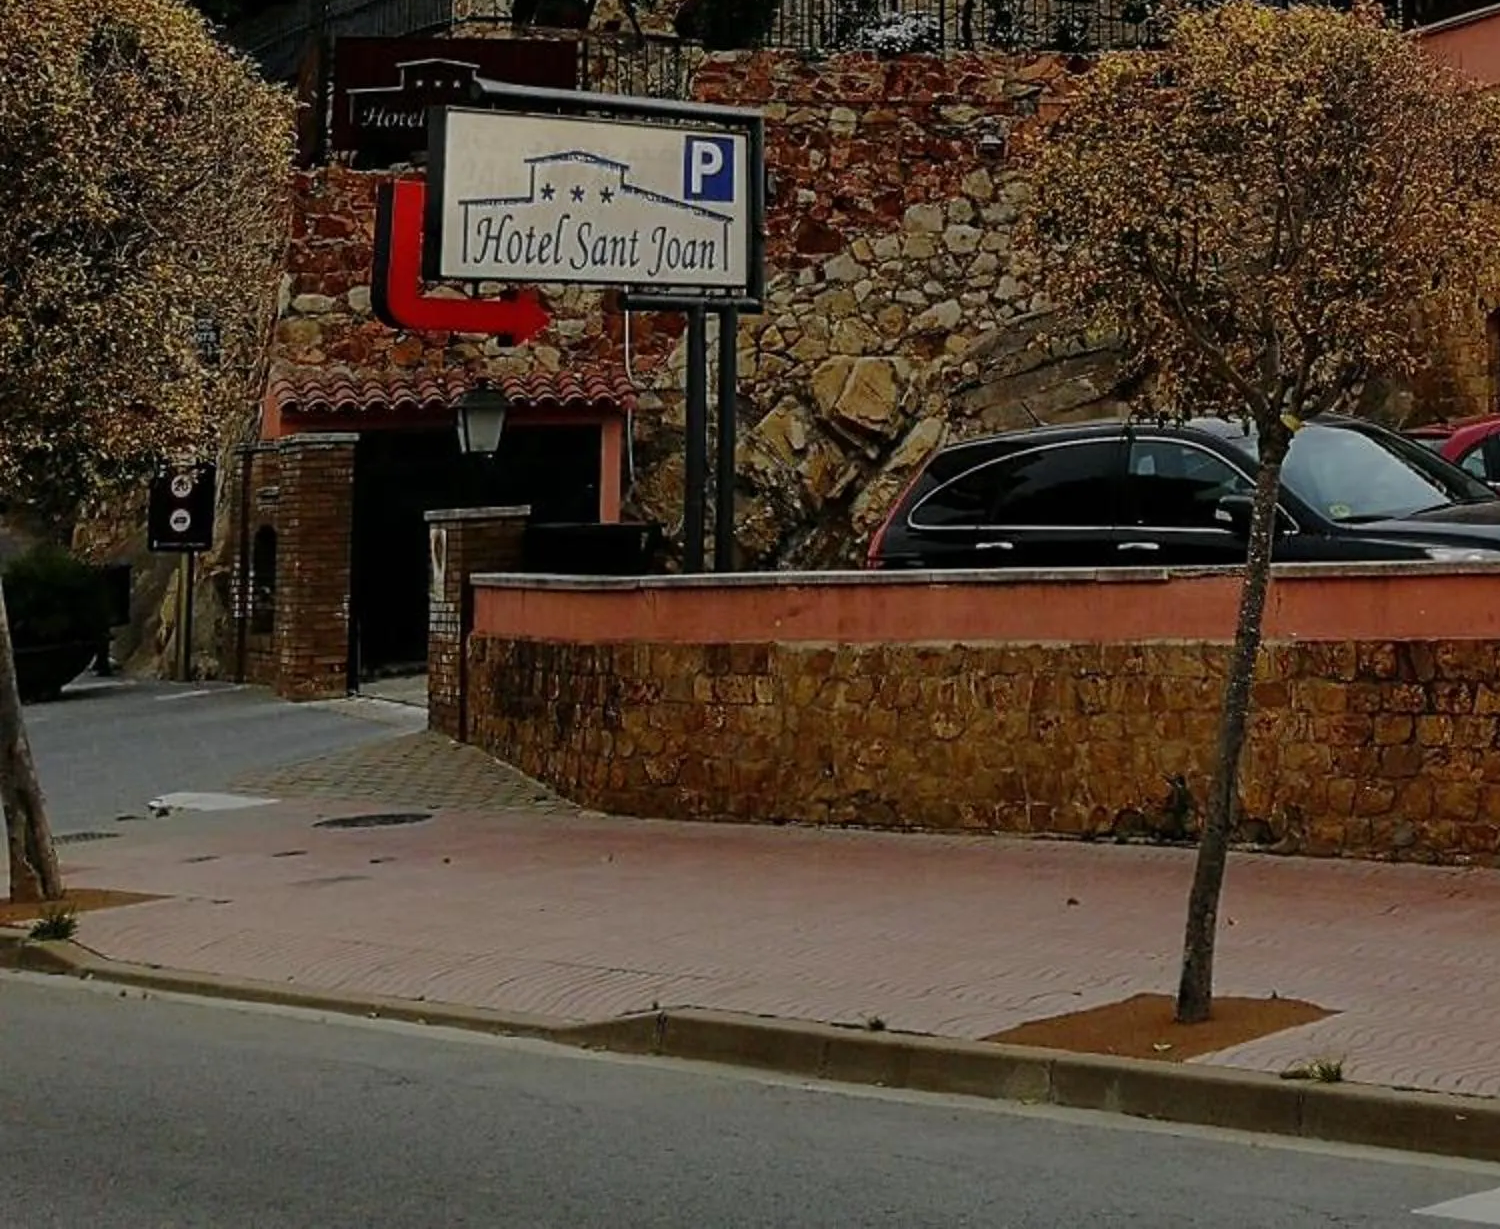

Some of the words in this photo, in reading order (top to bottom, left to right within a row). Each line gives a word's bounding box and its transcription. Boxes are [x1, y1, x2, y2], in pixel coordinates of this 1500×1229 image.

[360, 106, 425, 129] Hotel
[690, 140, 723, 195] P
[474, 213, 571, 267] Hotel
[569, 221, 640, 271] Sant
[648, 225, 716, 277] Joan
